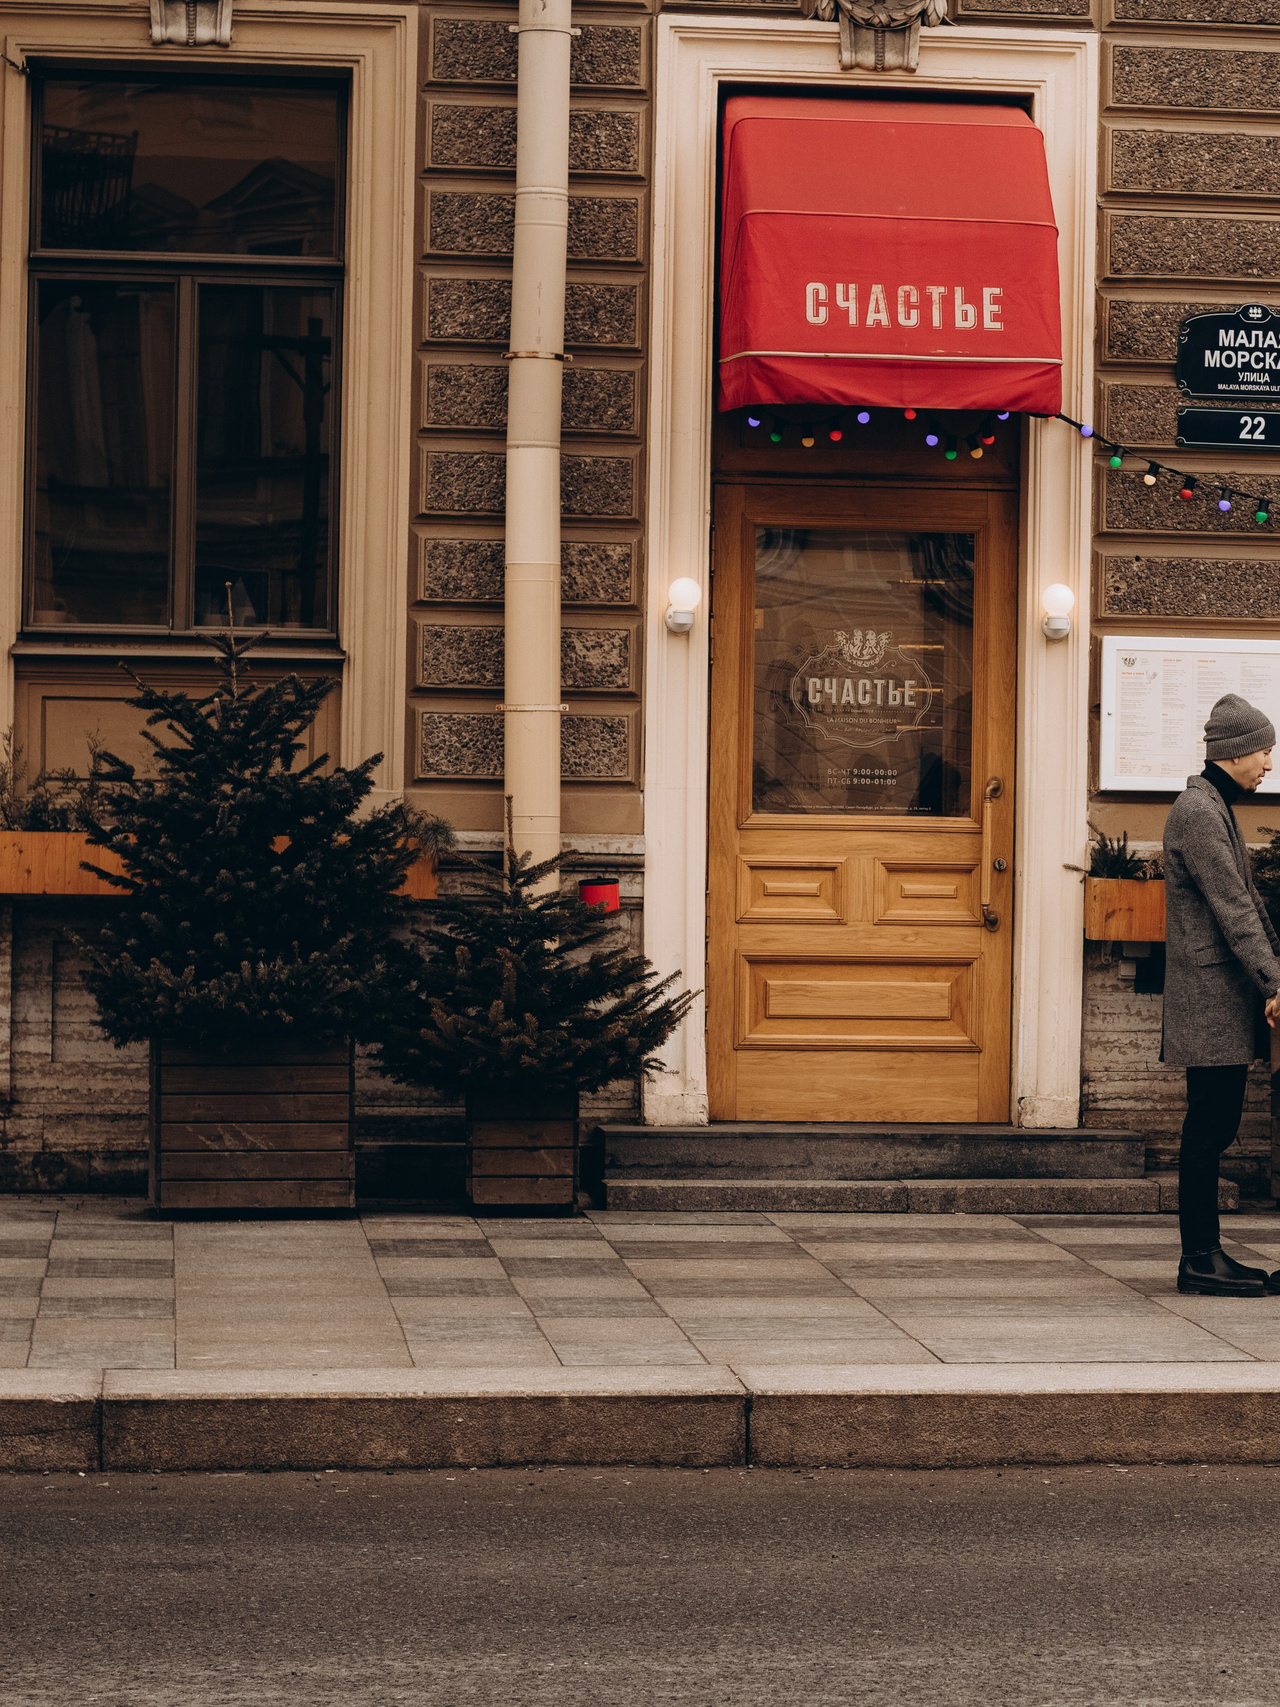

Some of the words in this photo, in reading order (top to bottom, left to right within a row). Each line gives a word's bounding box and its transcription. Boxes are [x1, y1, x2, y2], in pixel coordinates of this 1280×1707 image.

[805, 282, 1004, 330] СЧАСТЬЕ
[1238, 372, 1270, 383] УЛИЦА
[1217, 383, 1240, 391] MALAYA
[1239, 416, 1266, 440] 22
[808, 678, 917, 707] СЧАСТЬЕ
[852, 768, 898, 776] 9:00-00:00
[852, 778, 897, 786] 9:00-01:00
